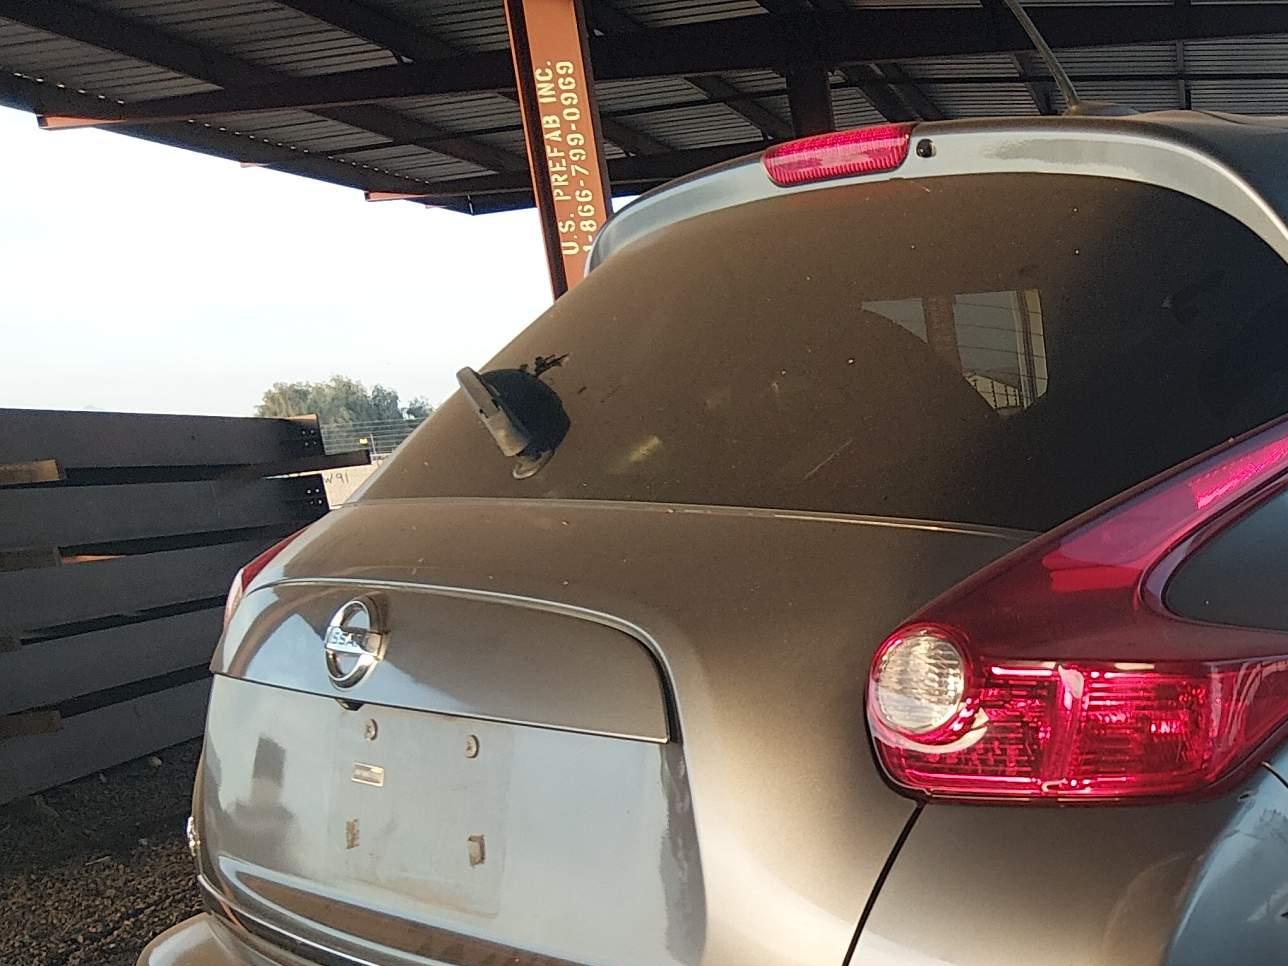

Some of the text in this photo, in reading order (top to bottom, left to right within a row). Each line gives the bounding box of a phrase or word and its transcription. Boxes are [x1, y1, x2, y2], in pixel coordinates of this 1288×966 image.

[535, 60, 580, 255] U.S. PREFAB INC.
